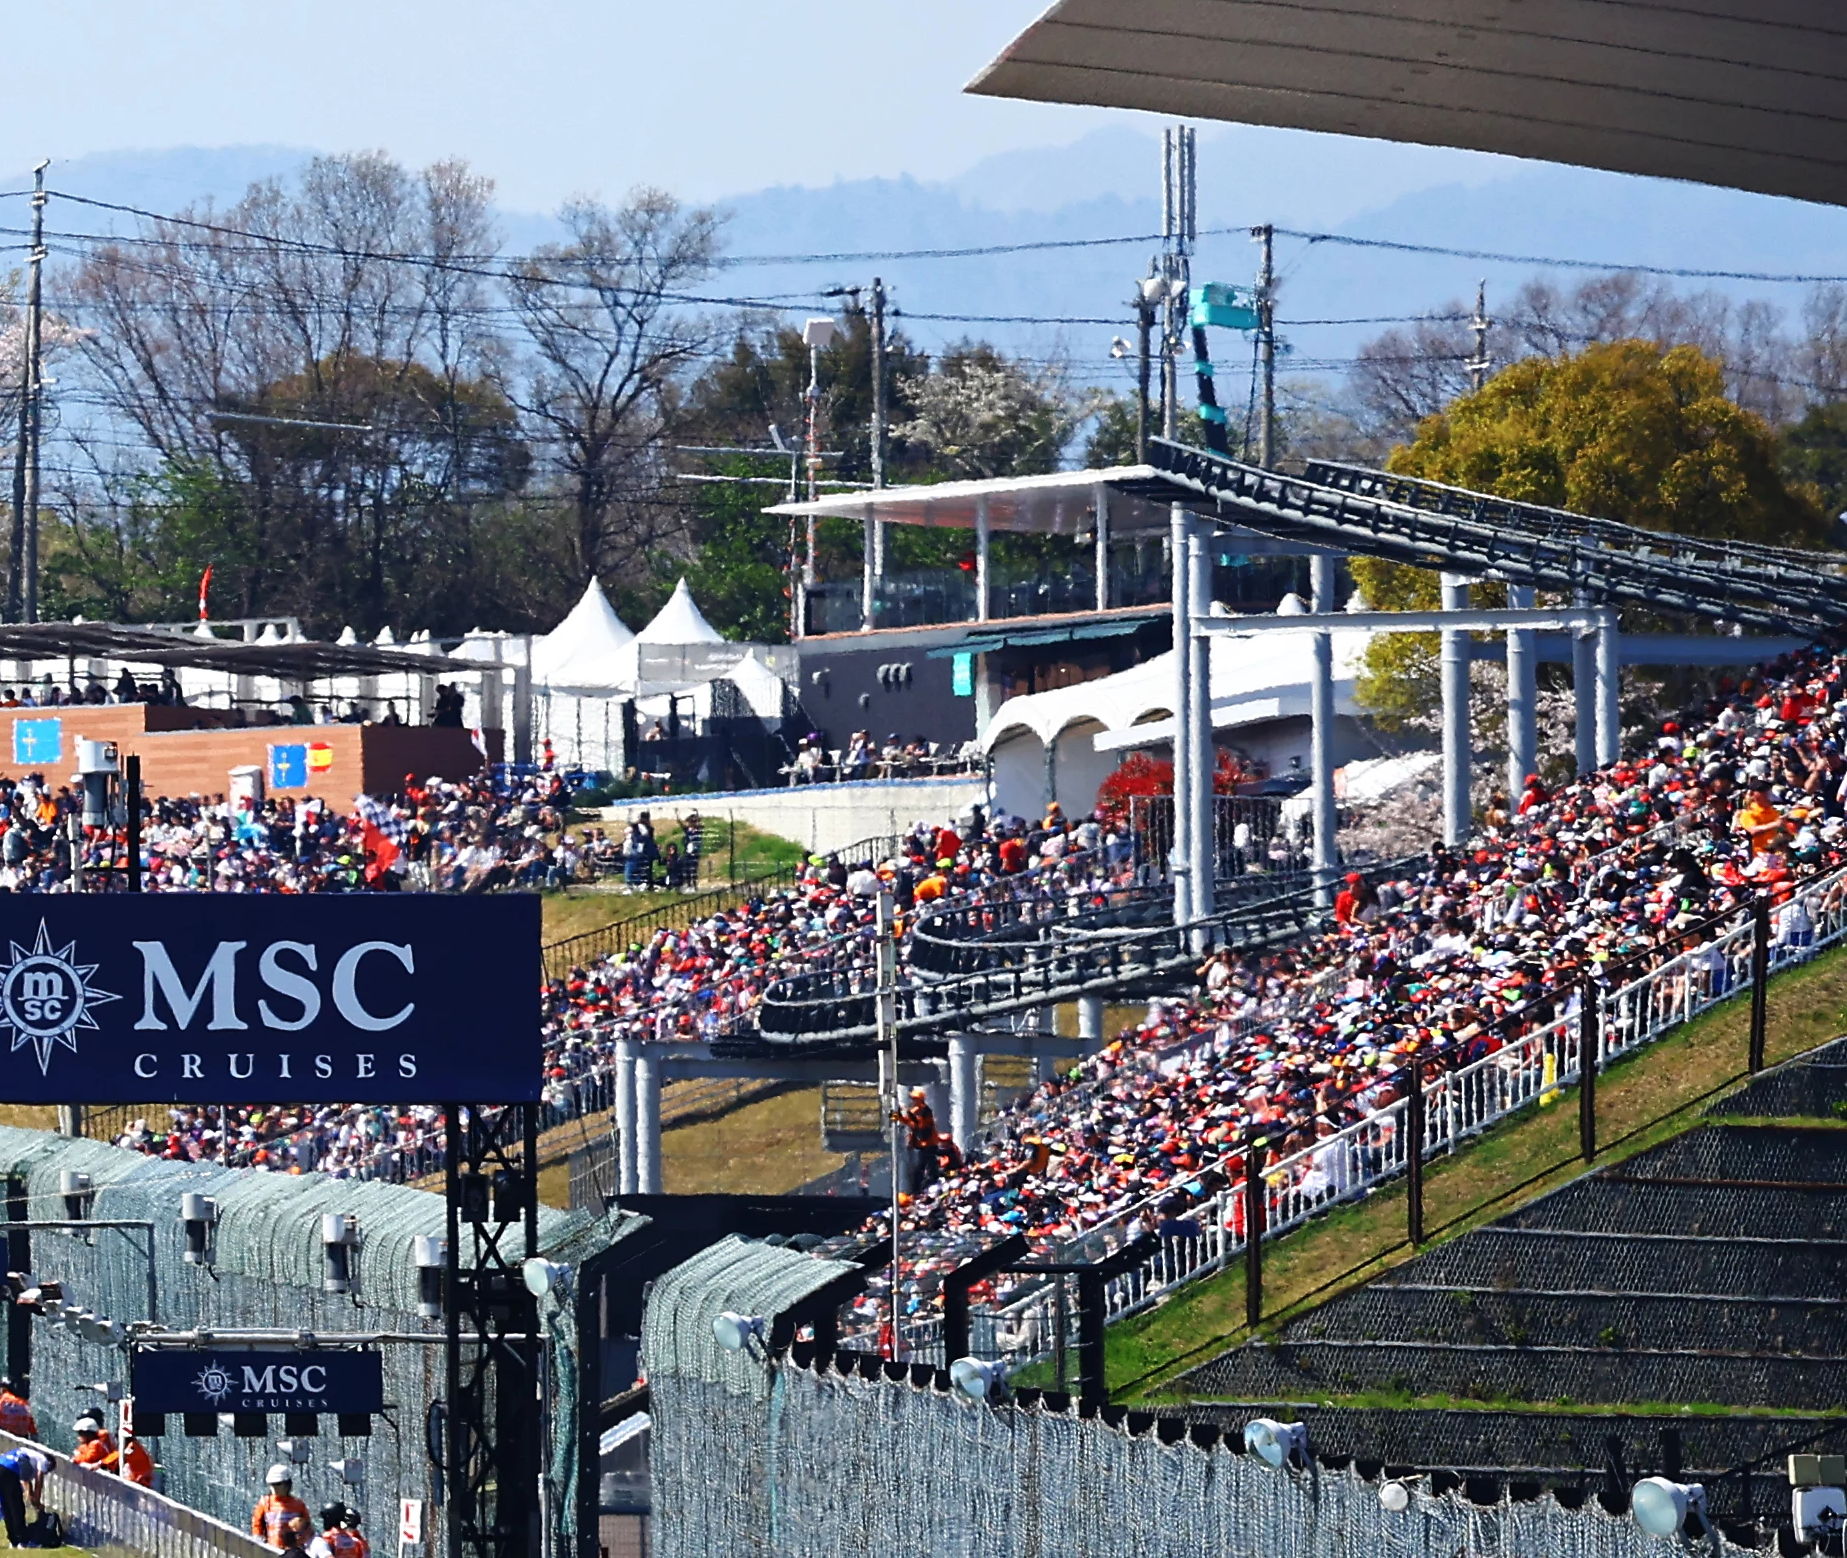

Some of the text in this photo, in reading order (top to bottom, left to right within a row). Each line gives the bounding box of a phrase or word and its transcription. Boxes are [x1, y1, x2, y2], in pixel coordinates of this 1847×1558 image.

[132, 939, 416, 1032] MSC
[133, 1052, 418, 1080] CRUISES
[240, 1364, 328, 1394] MSC
